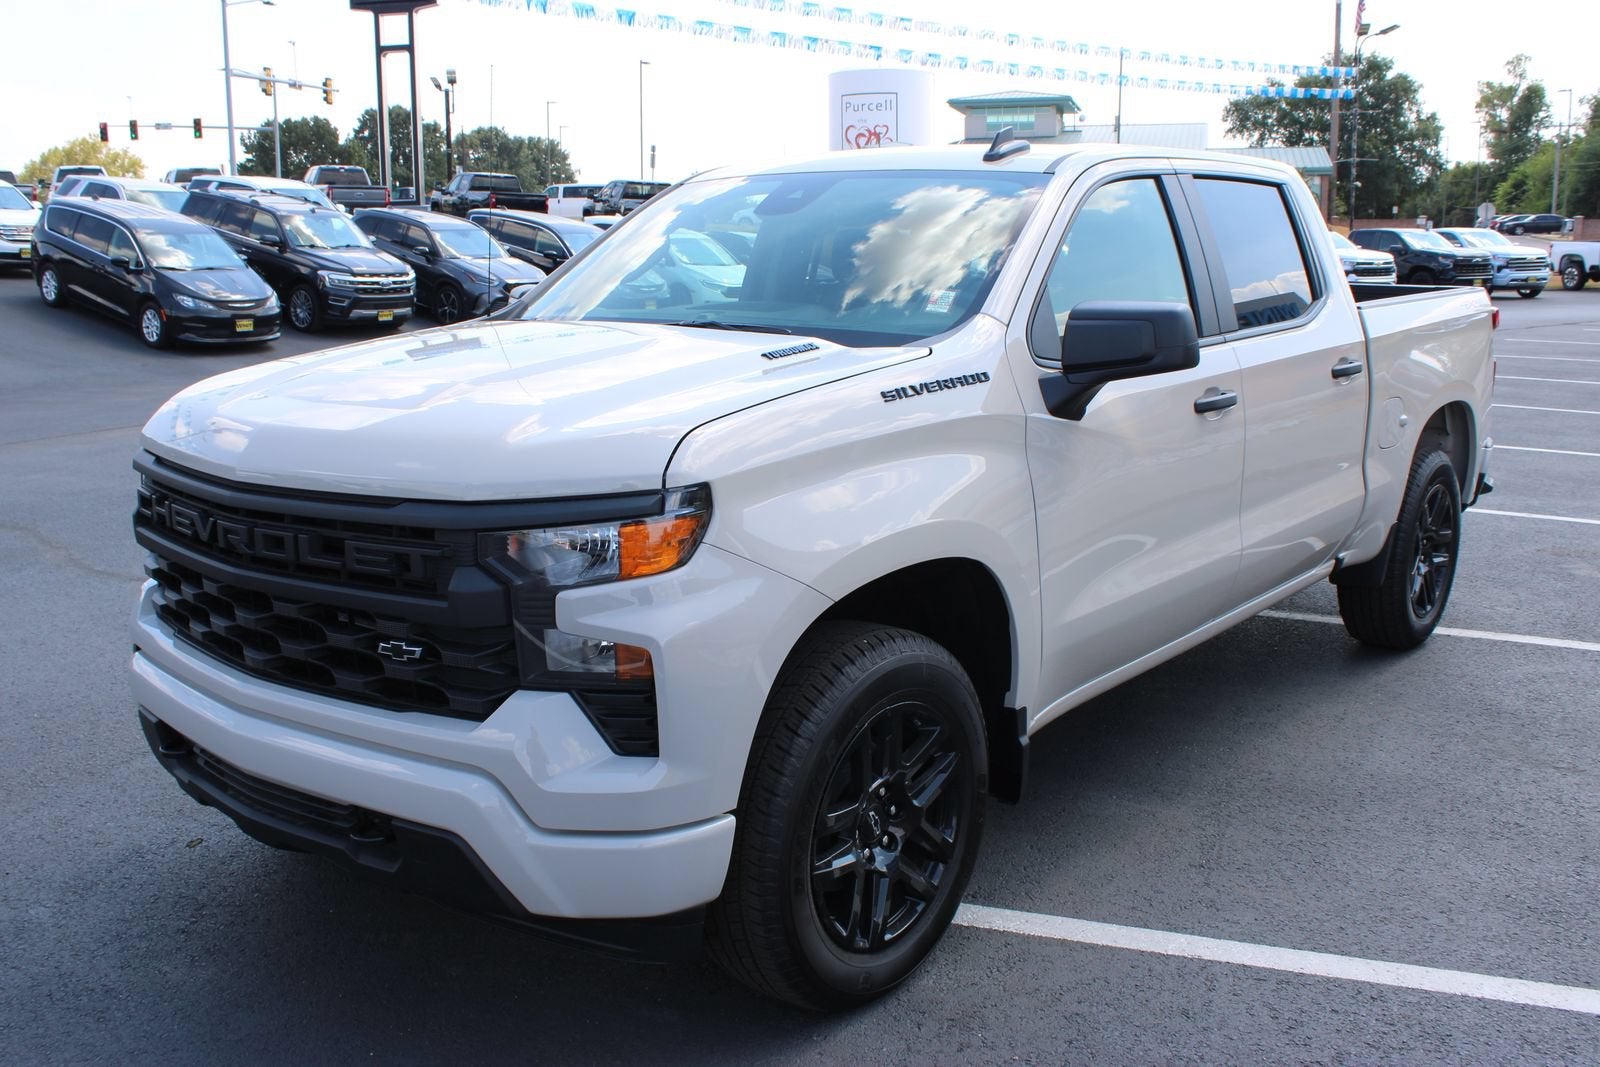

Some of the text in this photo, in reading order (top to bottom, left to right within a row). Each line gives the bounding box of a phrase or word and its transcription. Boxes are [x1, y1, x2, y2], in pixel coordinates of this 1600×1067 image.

[845, 99, 893, 112] Purcell
[880, 371, 991, 403] SILVERADO
[137, 487, 450, 578] CHEVROLET
